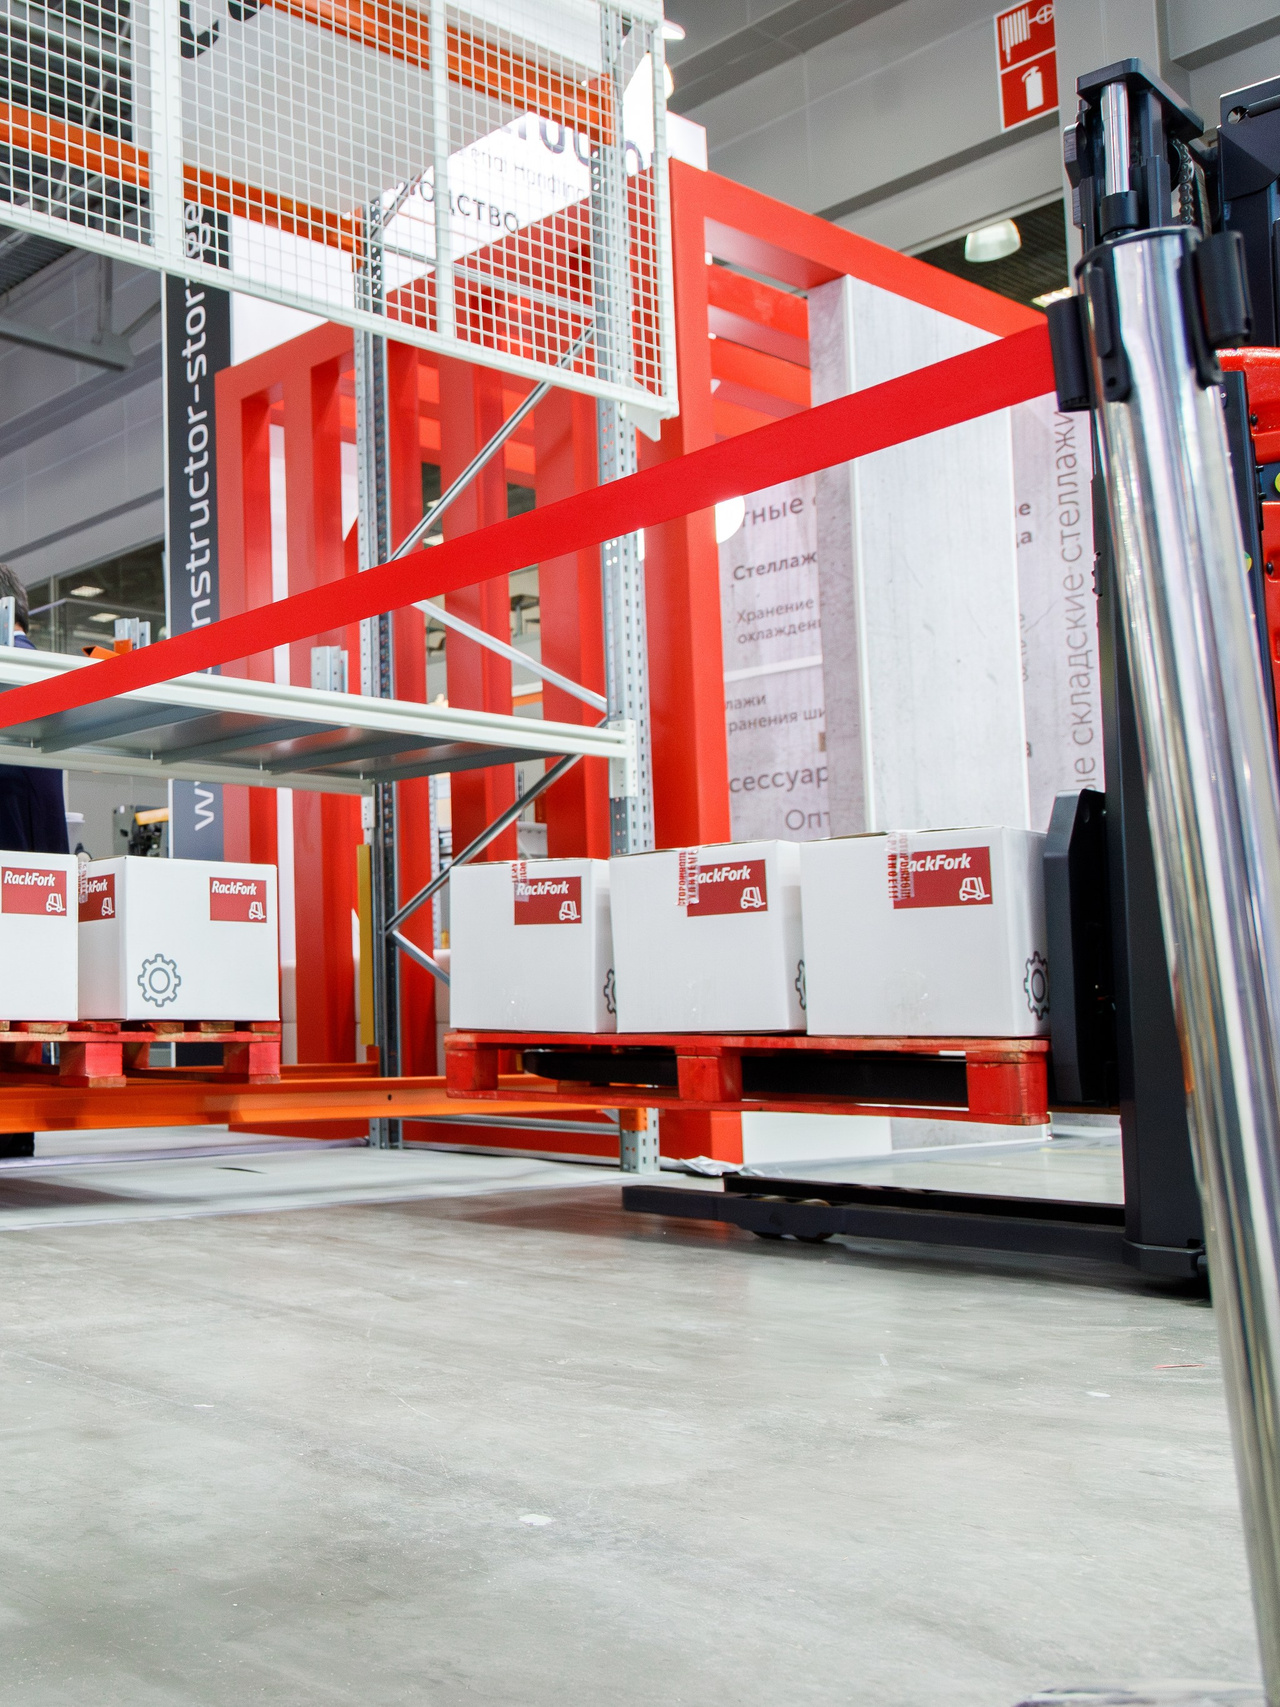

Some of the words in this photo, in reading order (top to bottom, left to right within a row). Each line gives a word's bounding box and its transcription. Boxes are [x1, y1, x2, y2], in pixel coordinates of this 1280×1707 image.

[1053, 411, 1083, 562] стеллажи
[737, 598, 814, 625] Хранение
[1063, 573, 1094, 746] складские
[3, 870, 56, 887] RackFork
[694, 865, 751, 884] ackFork
[211, 880, 257, 896] RackFork
[516, 880, 569, 896] RackFork
